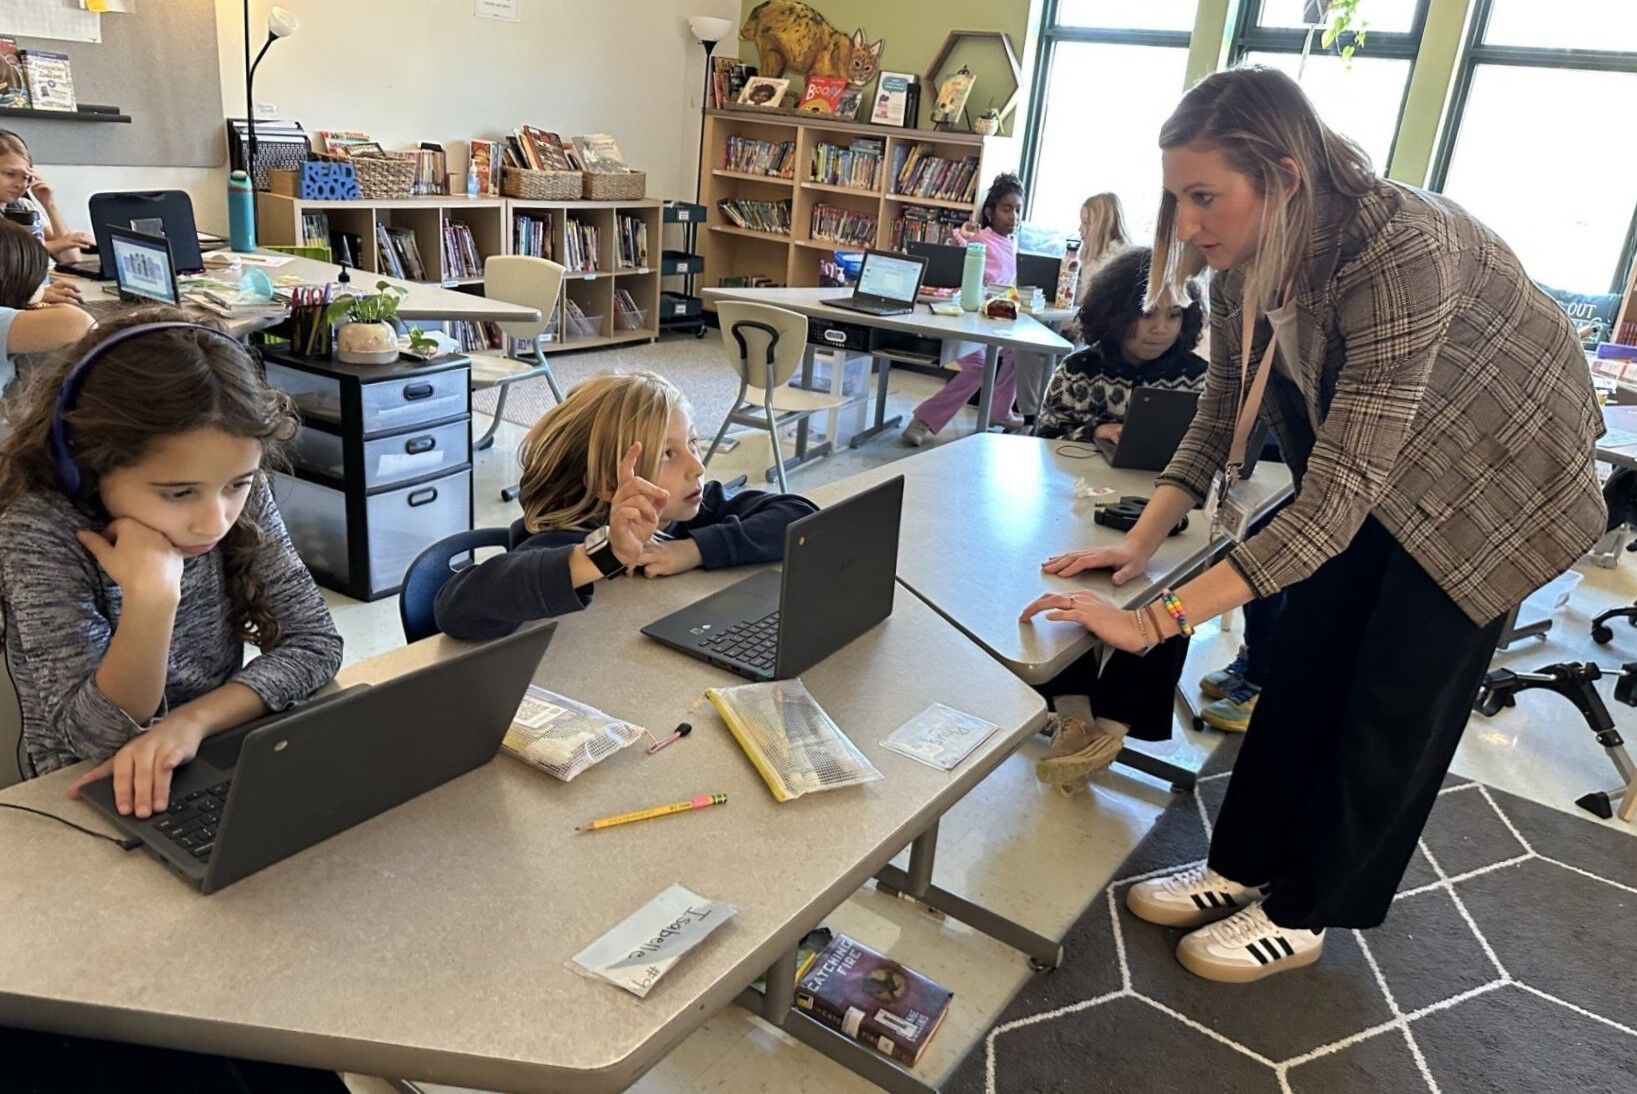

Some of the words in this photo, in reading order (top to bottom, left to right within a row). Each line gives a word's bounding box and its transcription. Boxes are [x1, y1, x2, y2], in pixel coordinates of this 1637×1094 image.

[304, 161, 356, 182] READ
[302, 180, 361, 200] BOOKS
[1568, 303, 1597, 318] OUT
[628, 906, 712, 960] Isabelle
[807, 939, 854, 993] CATCHING
[836, 948, 862, 976] FIRE
